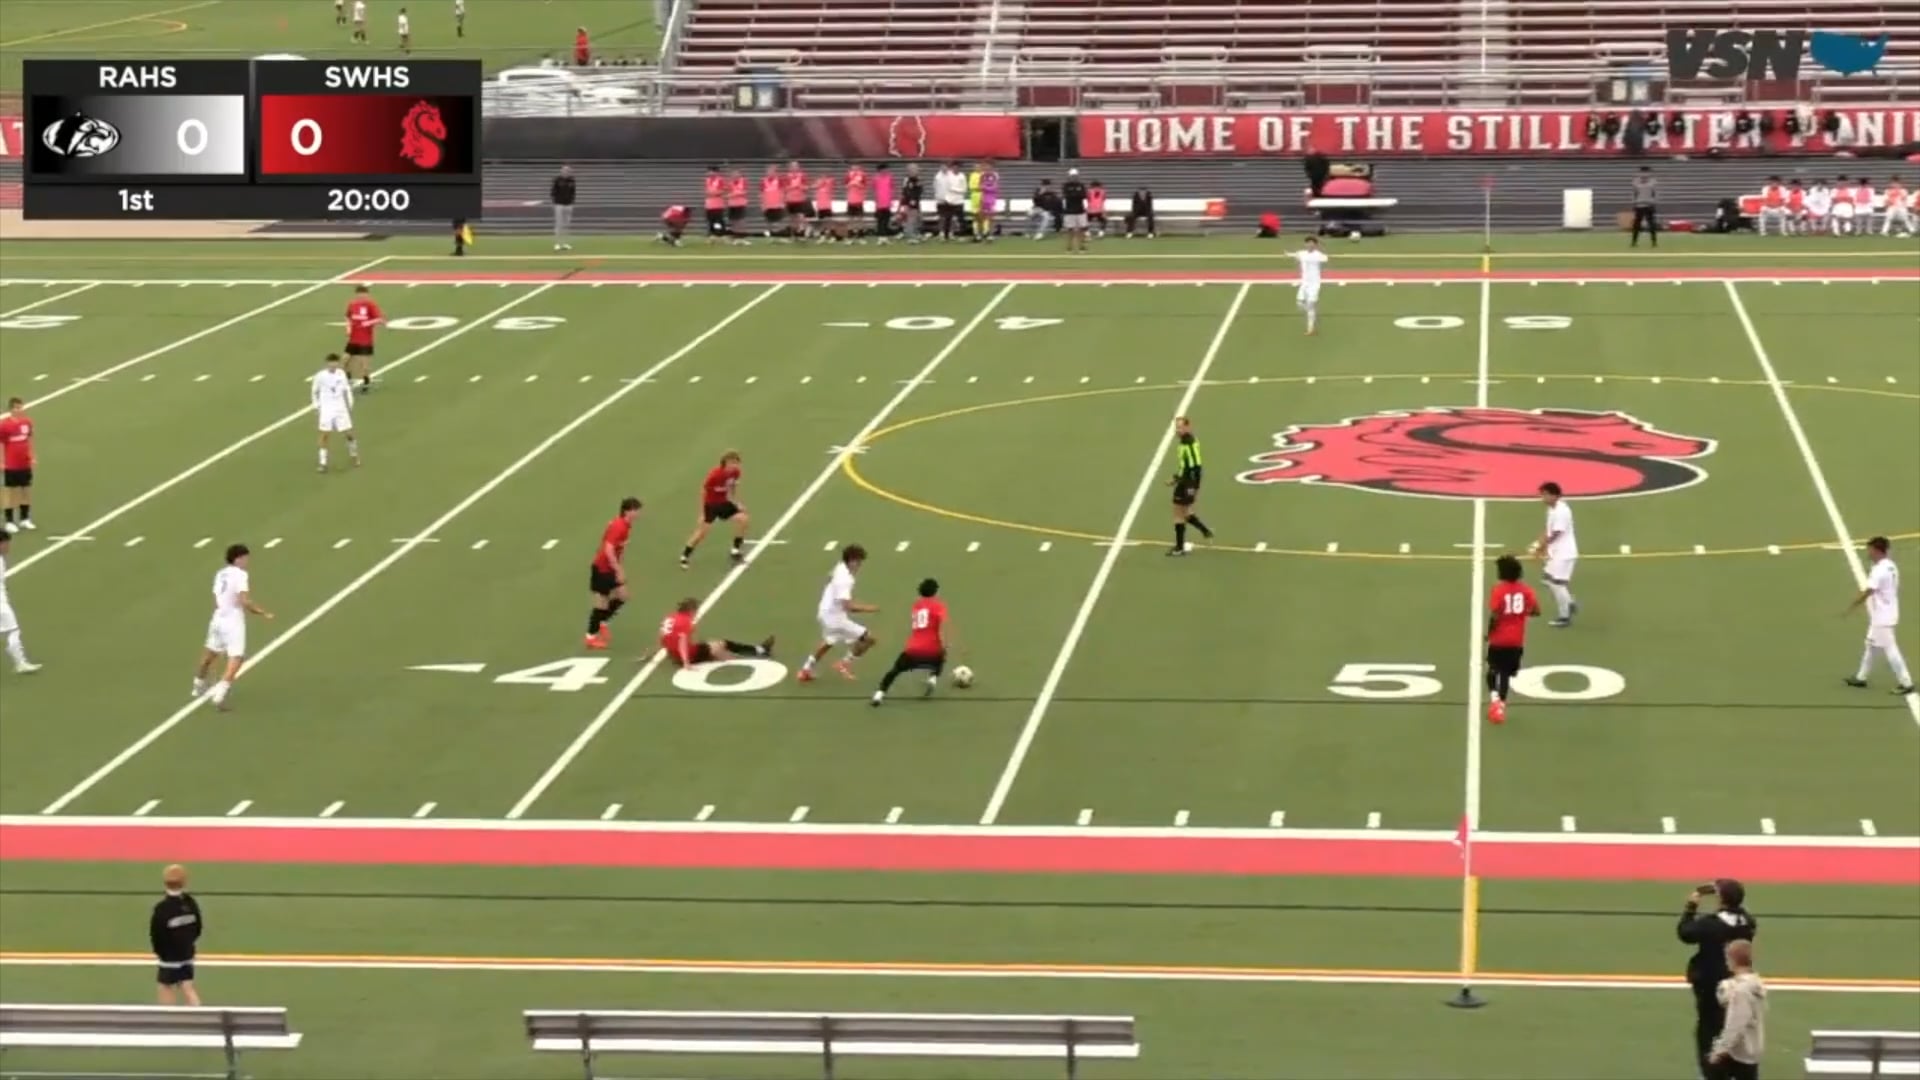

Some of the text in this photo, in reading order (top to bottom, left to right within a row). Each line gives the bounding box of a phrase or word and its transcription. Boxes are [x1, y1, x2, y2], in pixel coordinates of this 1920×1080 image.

[1104, 116, 1236, 152] HOME
[1258, 116, 1313, 151] OF
[1336, 115, 1425, 150] THE
